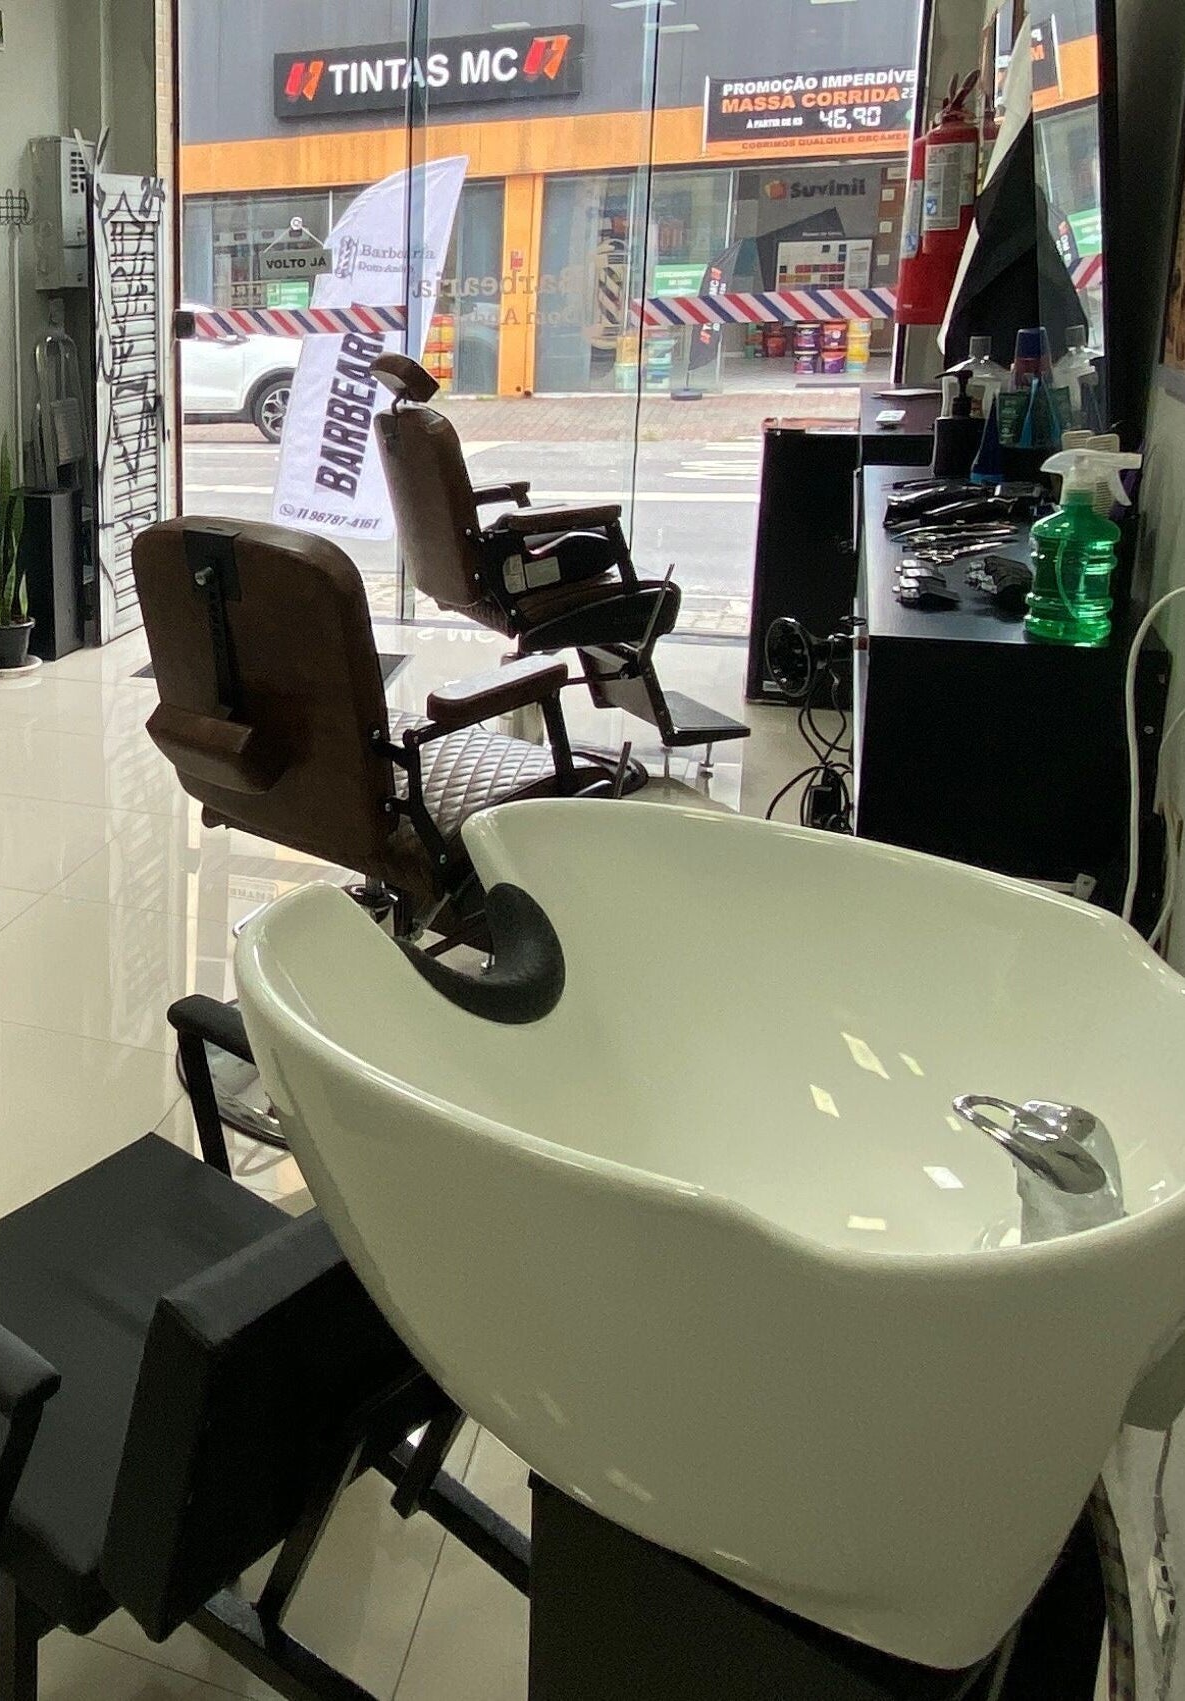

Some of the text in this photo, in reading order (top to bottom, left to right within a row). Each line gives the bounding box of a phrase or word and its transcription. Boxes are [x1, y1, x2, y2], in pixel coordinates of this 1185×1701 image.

[328, 47, 518, 95] TINTAS MC
[723, 69, 915, 96] PROMOÇÃO IMPERDÍVE
[722, 95, 795, 113] MASSA
[802, 87, 900, 108] CORRIDA
[819, 106, 881, 130] 46,90
[798, 135, 854, 147] QUALQUER
[790, 178, 866, 198] Suvinil
[266, 259, 306, 269] VOLTO
[316, 331, 386, 500] BARBEAR
[297, 508, 309, 519] 11
